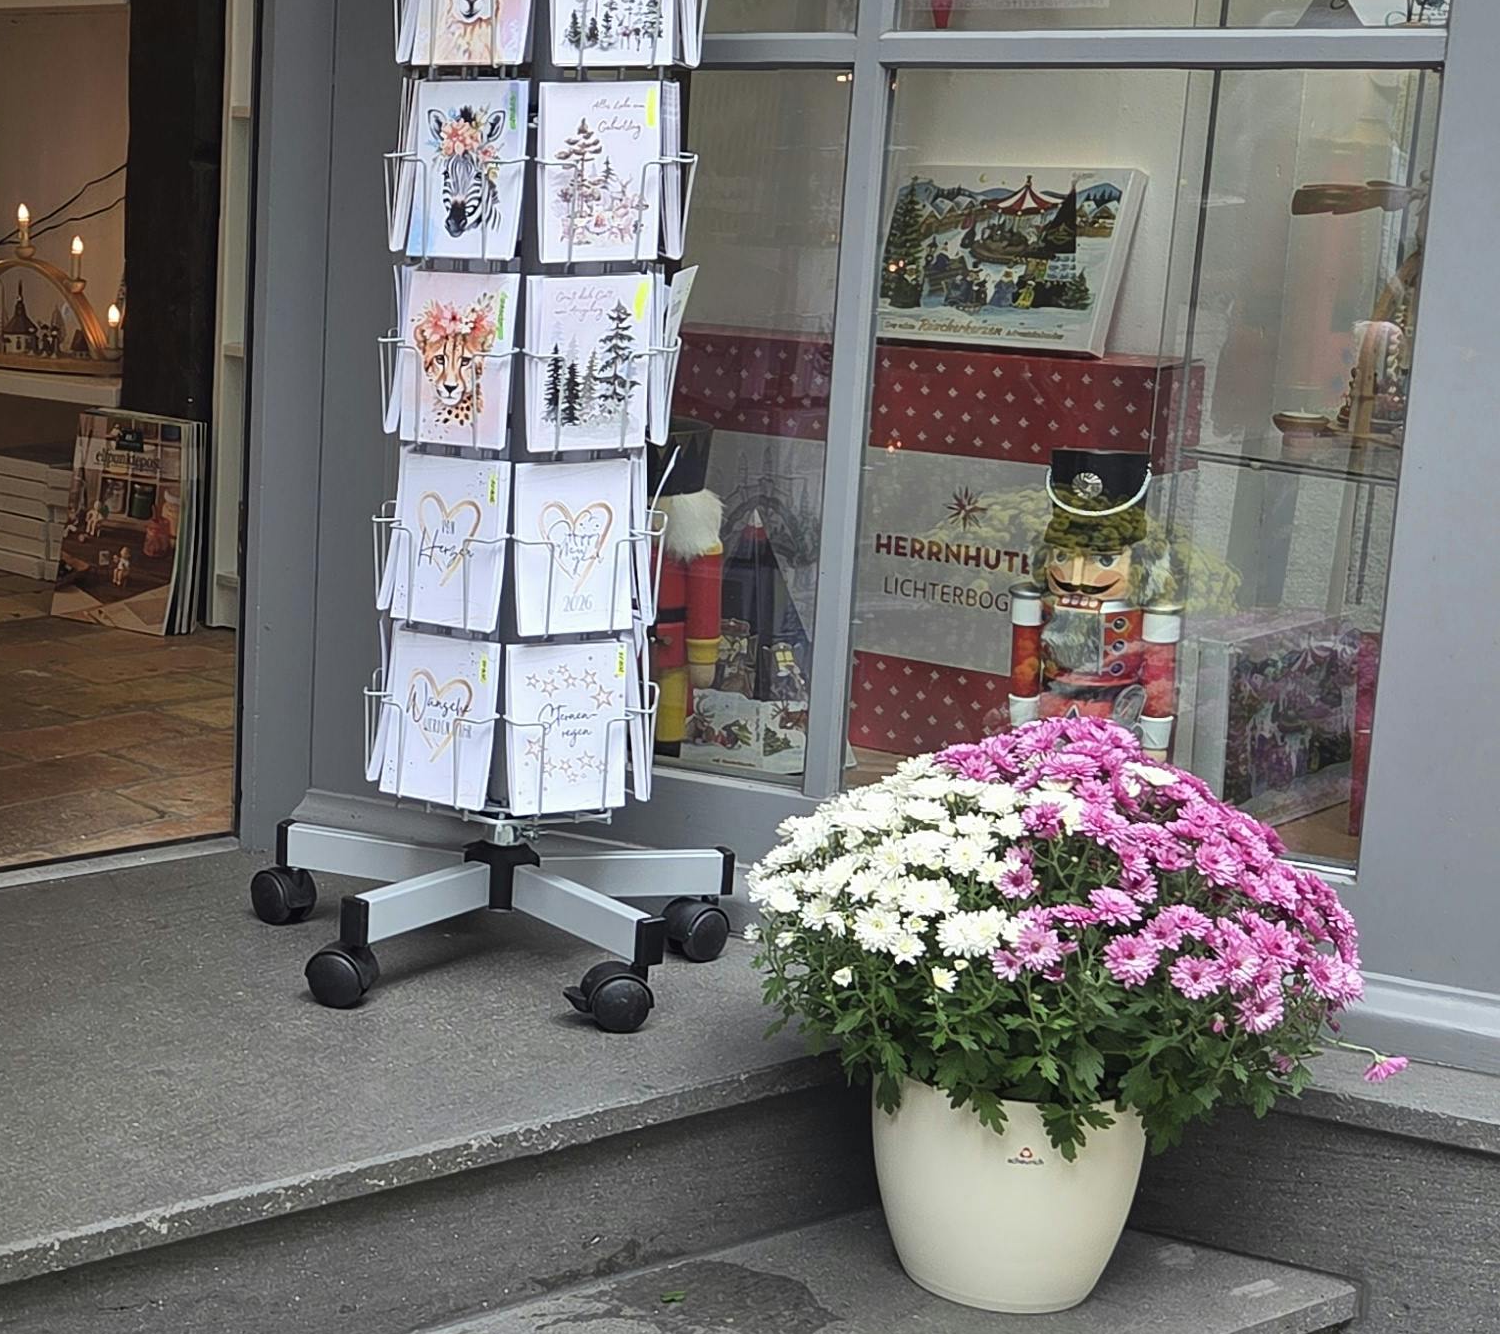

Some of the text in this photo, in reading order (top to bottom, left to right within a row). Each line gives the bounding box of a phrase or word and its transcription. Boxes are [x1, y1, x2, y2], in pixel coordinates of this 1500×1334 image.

[875, 533, 1031, 575] HERRNHUTE
[563, 593, 593, 613] 2026
[883, 575, 1009, 613] LICHTERBOG
